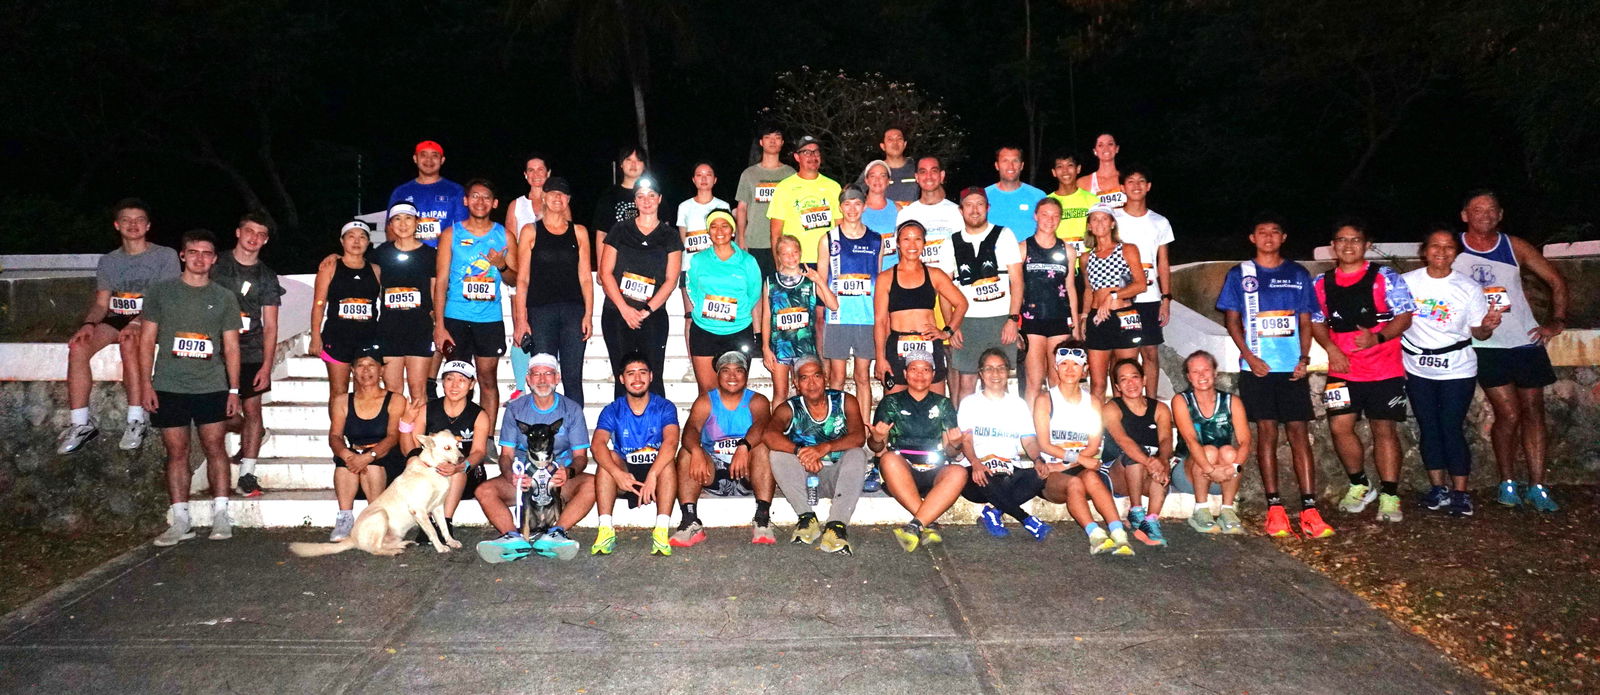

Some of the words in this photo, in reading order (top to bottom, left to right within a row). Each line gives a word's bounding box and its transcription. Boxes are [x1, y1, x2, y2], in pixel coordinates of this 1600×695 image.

[760, 188, 775, 197] 098
[1100, 193, 1122, 203] 0942
[421, 211, 447, 219] SAIPAN
[806, 212, 827, 223] 0956
[416, 223, 434, 233] 966
[688, 236, 708, 246] 0973
[921, 246, 942, 257] 089
[468, 283, 490, 294] 0962
[625, 279, 647, 294] 0951
[844, 281, 864, 290] 0971
[976, 283, 999, 295] 0953
[389, 293, 414, 303] 0955
[113, 299, 137, 309] 0980
[343, 304, 367, 314] 0893
[708, 301, 730, 314] 0975
[781, 313, 802, 325] 0970
[1262, 317, 1290, 329] 0983
[178, 339, 206, 352] 0978
[903, 342, 926, 352] 0976
[1418, 356, 1449, 368] 0954
[974, 426, 991, 437] RUN
[1052, 430, 1066, 440] RUN
[718, 439, 737, 449] 089
[631, 453, 657, 463] 0943
[985, 458, 1009, 470] 0944
